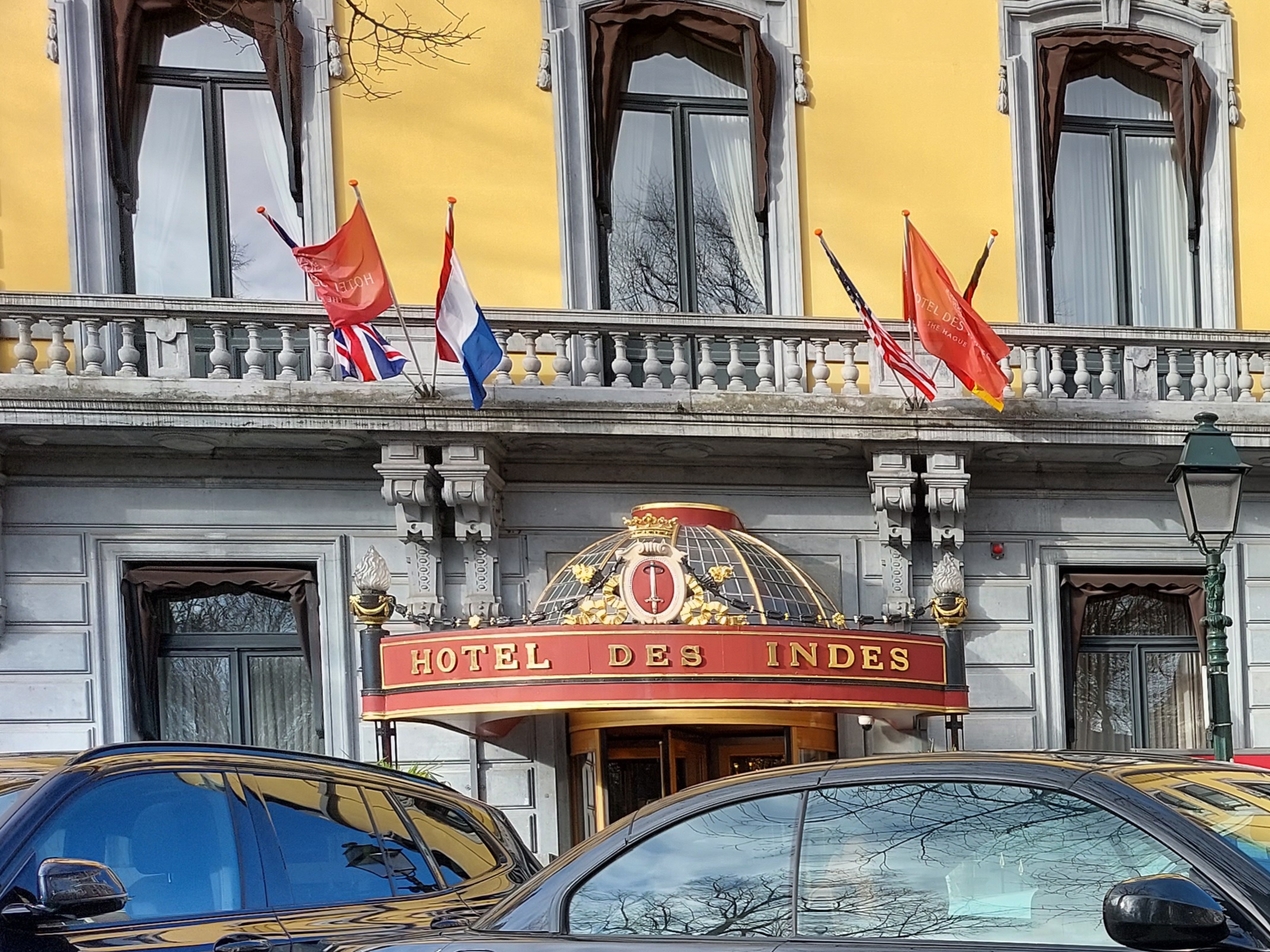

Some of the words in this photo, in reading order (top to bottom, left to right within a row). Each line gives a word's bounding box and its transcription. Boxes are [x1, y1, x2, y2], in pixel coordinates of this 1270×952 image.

[914, 290, 939, 316] OTEL
[942, 311, 966, 331] DES
[927, 320, 941, 332] THE
[942, 328, 968, 348] HAGUE
[411, 642, 552, 675] HOTEL
[608, 643, 705, 668] DES
[767, 641, 911, 672] INDES
